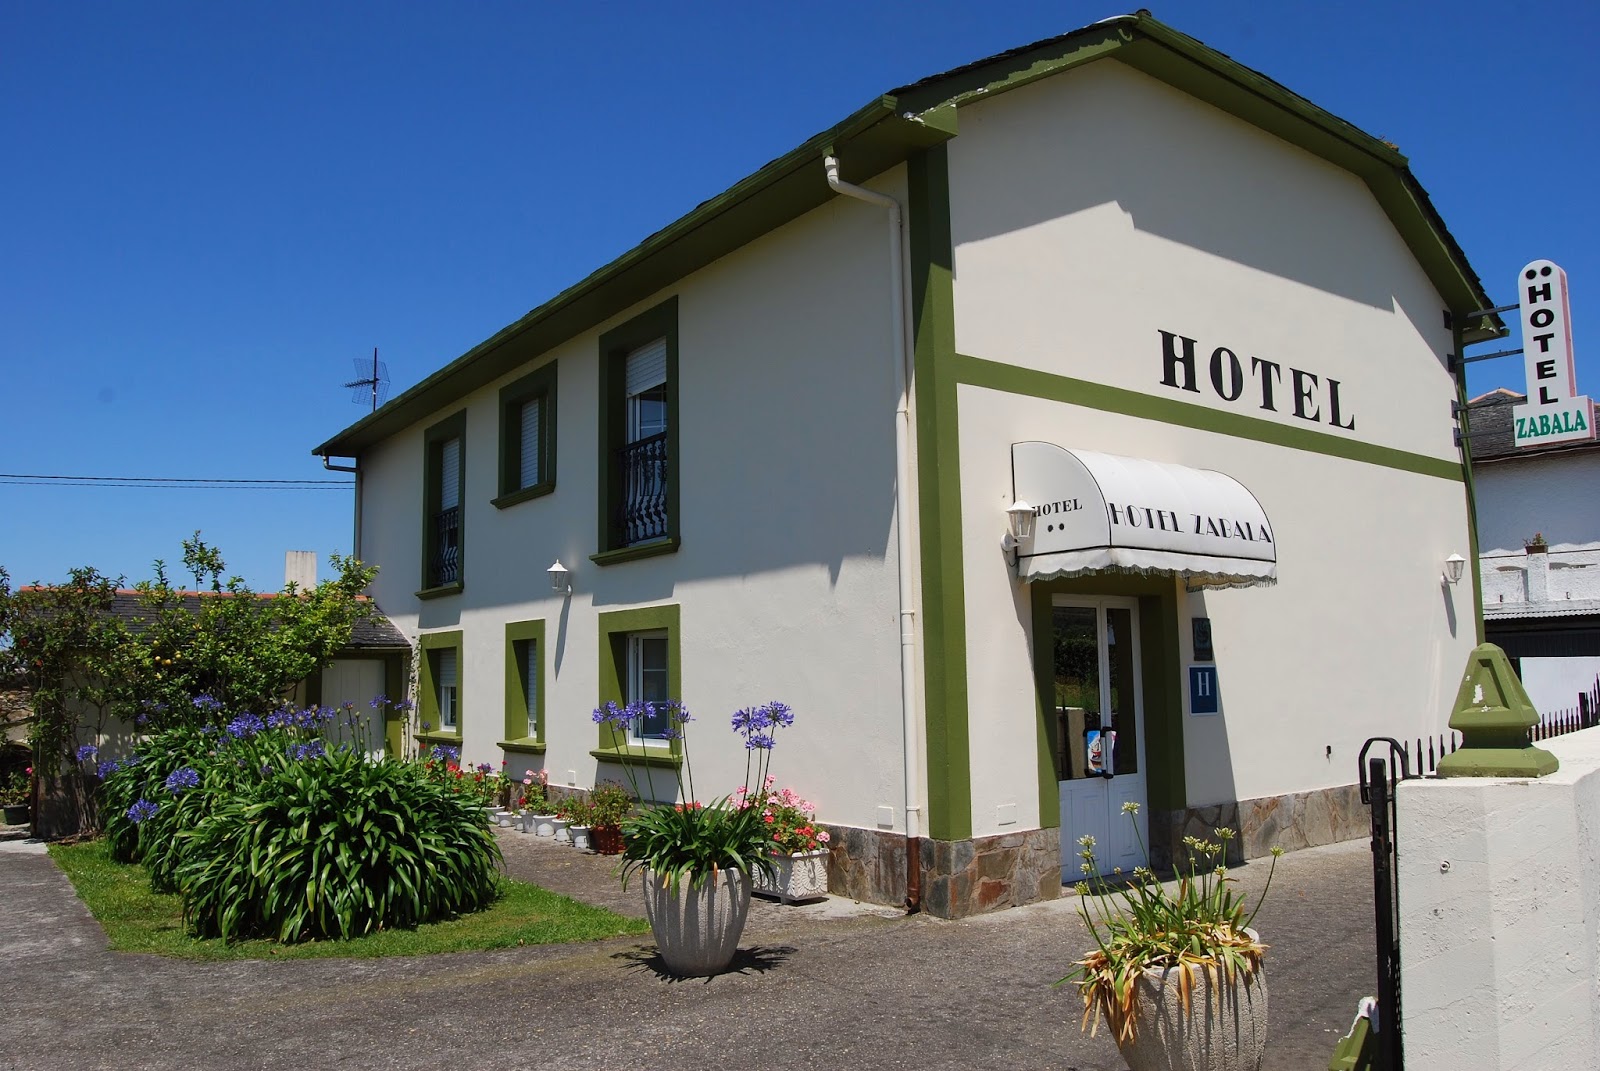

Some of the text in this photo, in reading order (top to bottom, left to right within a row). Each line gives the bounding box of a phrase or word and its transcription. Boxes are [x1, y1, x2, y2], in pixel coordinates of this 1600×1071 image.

[1528, 282, 1558, 405] HOTEL
[1157, 329, 1355, 430] HOTEL
[1516, 409, 1587, 439] ZABALA
[1031, 498, 1083, 517] HOTEL
[1108, 502, 1272, 543] HOTEL ZABALA
[1197, 671, 1210, 697] H
